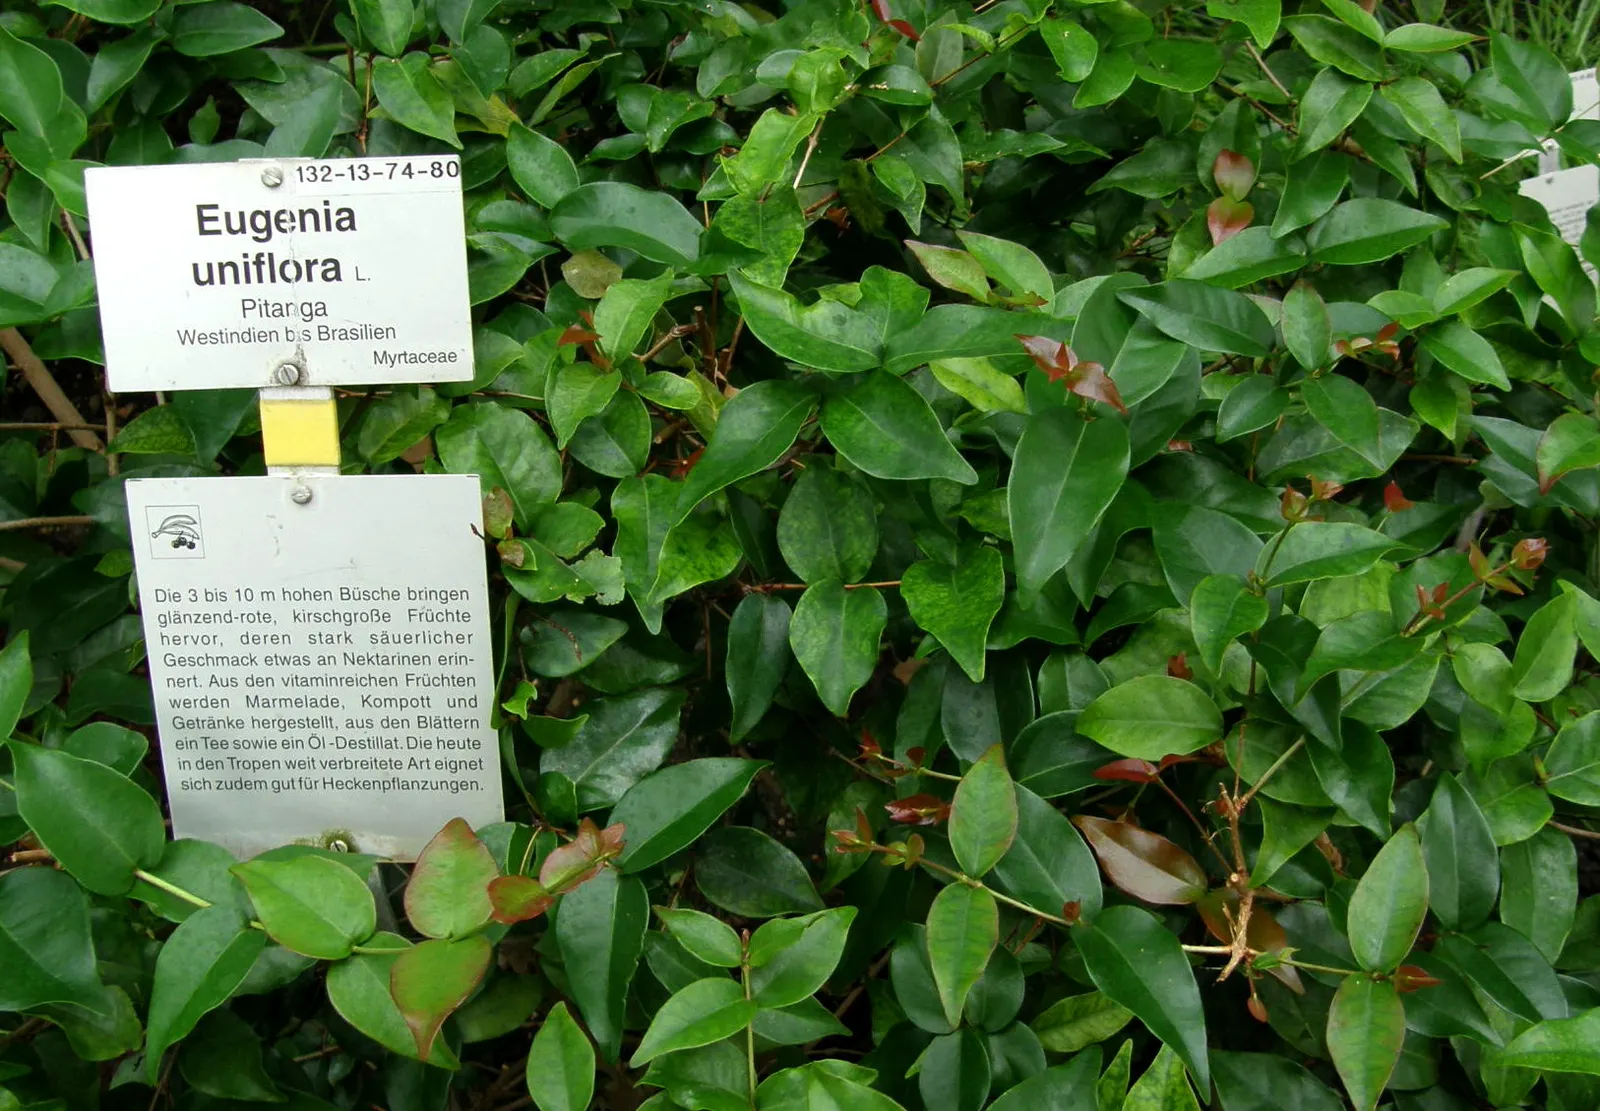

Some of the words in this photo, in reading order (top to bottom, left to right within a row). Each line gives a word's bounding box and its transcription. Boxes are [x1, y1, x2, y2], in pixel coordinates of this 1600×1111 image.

[297, 161, 459, 183] 132-13-74-80
[196, 200, 357, 242] Eugenia
[192, 253, 342, 285] uniflora
[355, 267, 371, 281] L.
[178, 326, 279, 346] Westindien
[318, 324, 396, 341] Brasilien
[373, 350, 457, 368] Myrtaceae
[154, 588, 182, 603] Die
[188, 588, 198, 602] 3
[204, 588, 228, 602] bis
[235, 587, 254, 602] 10
[260, 591, 275, 602] m
[282, 588, 332, 601] hohen
[340, 586, 400, 601] Büsche
[407, 587, 469, 604] bringen
[158, 610, 277, 628] glänzend-rote,
[293, 609, 391, 626] kirschgroße
[408, 609, 471, 623] Früchte
[161, 632, 224, 647] hervor,
[240, 632, 291, 645] deren
[308, 631, 353, 645] stark
[370, 630, 473, 645] säuerlicher
[164, 653, 258, 668] Geschmack
[264, 655, 311, 667] etwas
[317, 656, 336, 666] an
[344, 653, 431, 667] Nektarinen
[438, 653, 474, 666] erin-
[166, 677, 203, 689] nert.
[209, 675, 238, 688] Aus
[245, 674, 275, 688] den
[281, 674, 398, 688] vitaminreichen
[405, 673, 476, 688] Früchten
[169, 696, 230, 709] werden
[246, 696, 345, 710] Marmelade,
[361, 696, 431, 711] Kompott
[447, 695, 477, 709] und
[172, 716, 245, 730] Getränke
[251, 716, 338, 732] hergestellt,
[345, 718, 374, 729] aus
[380, 716, 410, 729] den
[417, 716, 480, 729] Blättern
[175, 737, 198, 751] ein
[201, 737, 228, 750] Tee
[233, 737, 277, 750] sowie
[281, 737, 304, 749] ein
[406, 737, 432, 750] Die
[437, 737, 481, 750] heute
[178, 757, 191, 770] in
[195, 757, 224, 770] den
[227, 757, 281, 774] Tropen
[285, 757, 316, 770] weit
[320, 757, 403, 770] verbreitete
[407, 757, 431, 770] Art
[434, 757, 483, 773] eignet
[181, 777, 212, 791] sich
[216, 777, 267, 791] zudem
[271, 778, 296, 794] gut
[298, 777, 319, 791] für
[323, 777, 484, 794] Heckenpflanzungen.
